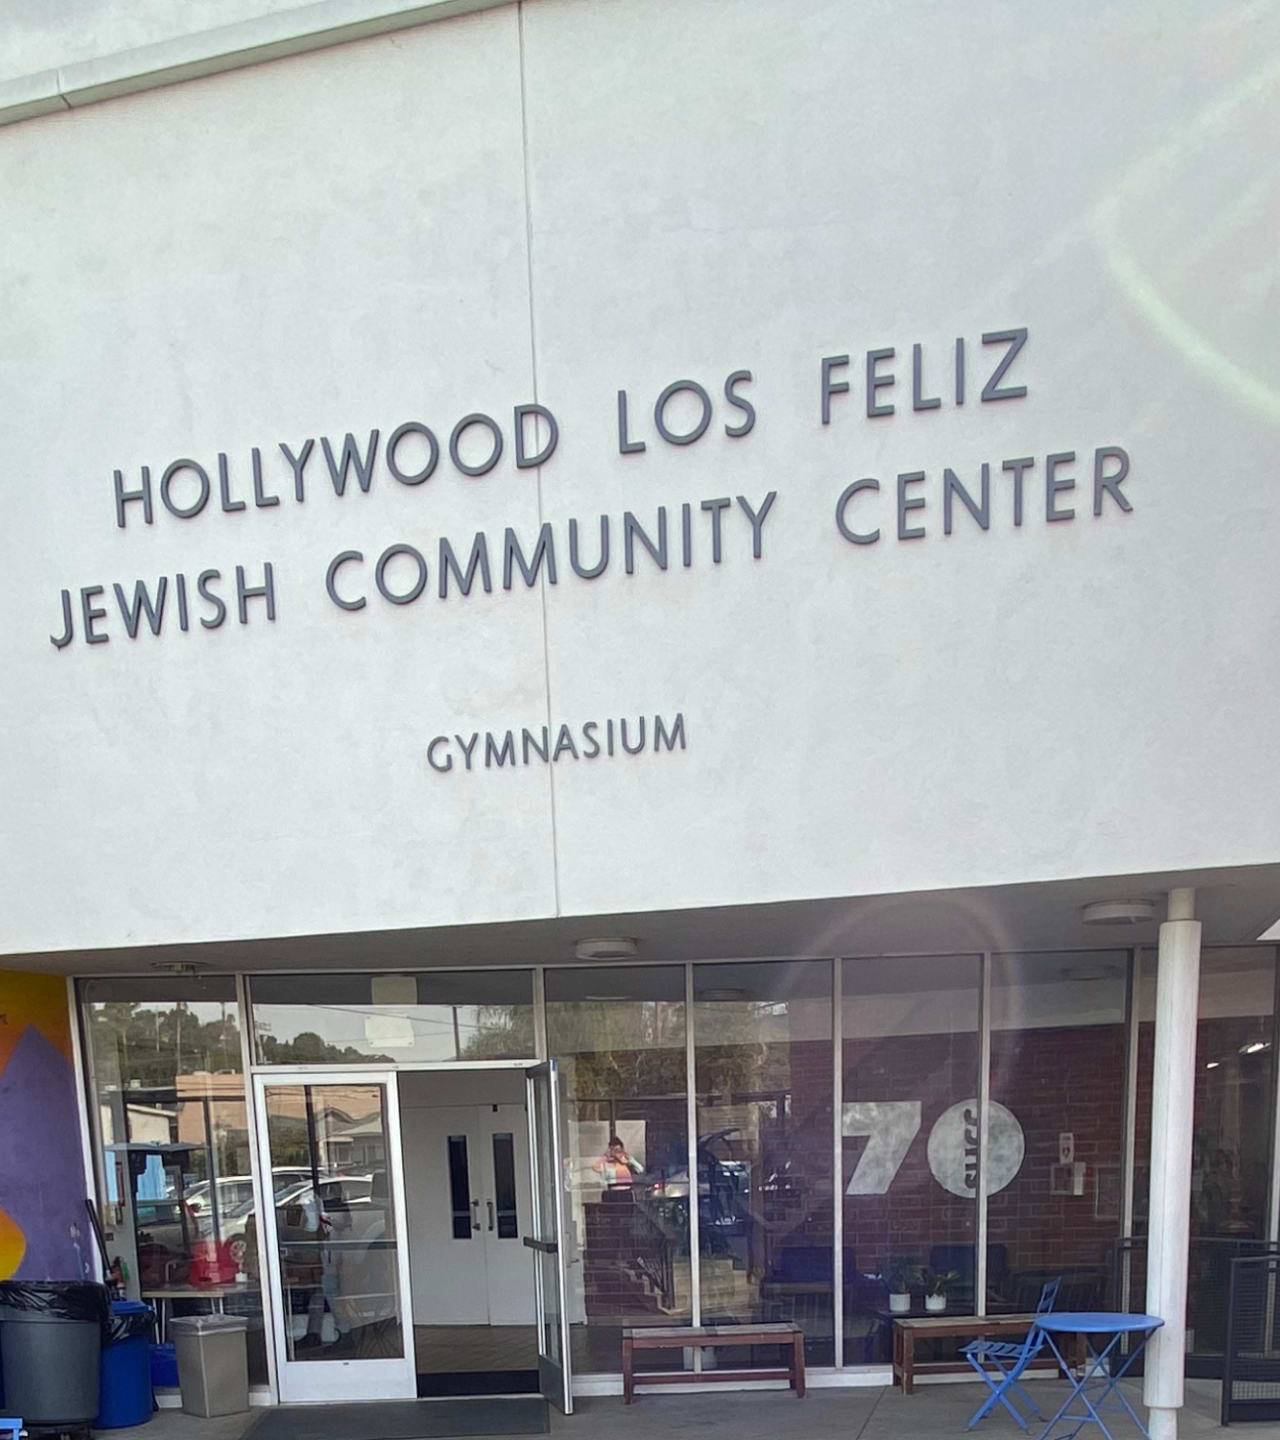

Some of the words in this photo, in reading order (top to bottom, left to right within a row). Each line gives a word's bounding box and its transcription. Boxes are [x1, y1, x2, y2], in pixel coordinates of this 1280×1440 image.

[113, 402, 559, 528] HOLLYWOOD
[617, 369, 756, 455] LOS
[821, 327, 1029, 425] FELIZ
[50, 561, 276, 649] JEWISH
[326, 491, 777, 611] COMMUNITY
[835, 446, 1134, 545] CENTER
[426, 712, 687, 773] GYMNASIUM
